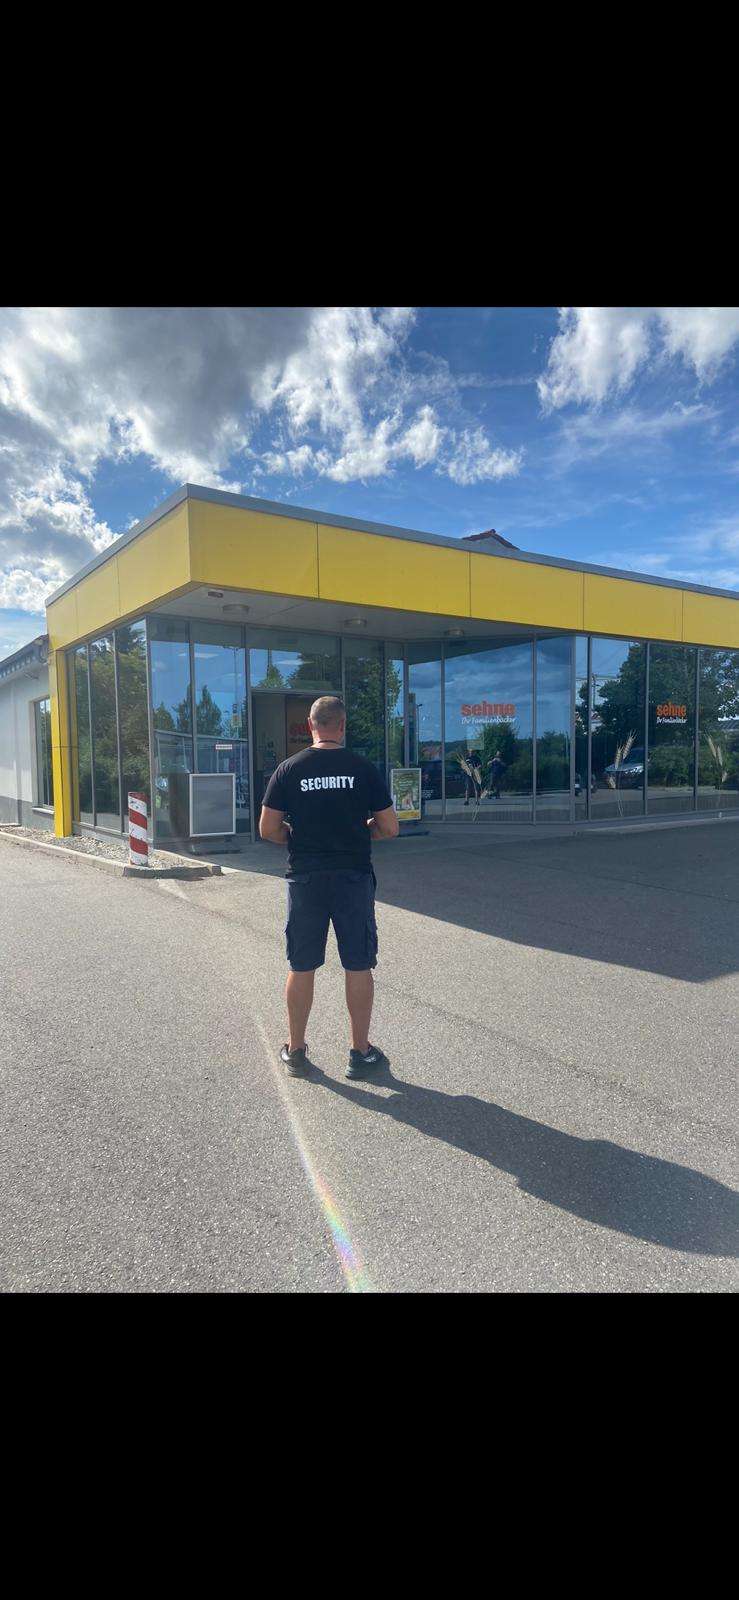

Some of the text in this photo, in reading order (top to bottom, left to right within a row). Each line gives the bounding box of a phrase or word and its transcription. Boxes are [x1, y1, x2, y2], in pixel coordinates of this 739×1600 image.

[461, 701, 515, 716] sehne
[656, 701, 687, 717] sehne
[300, 776, 354, 792] SECURITY
